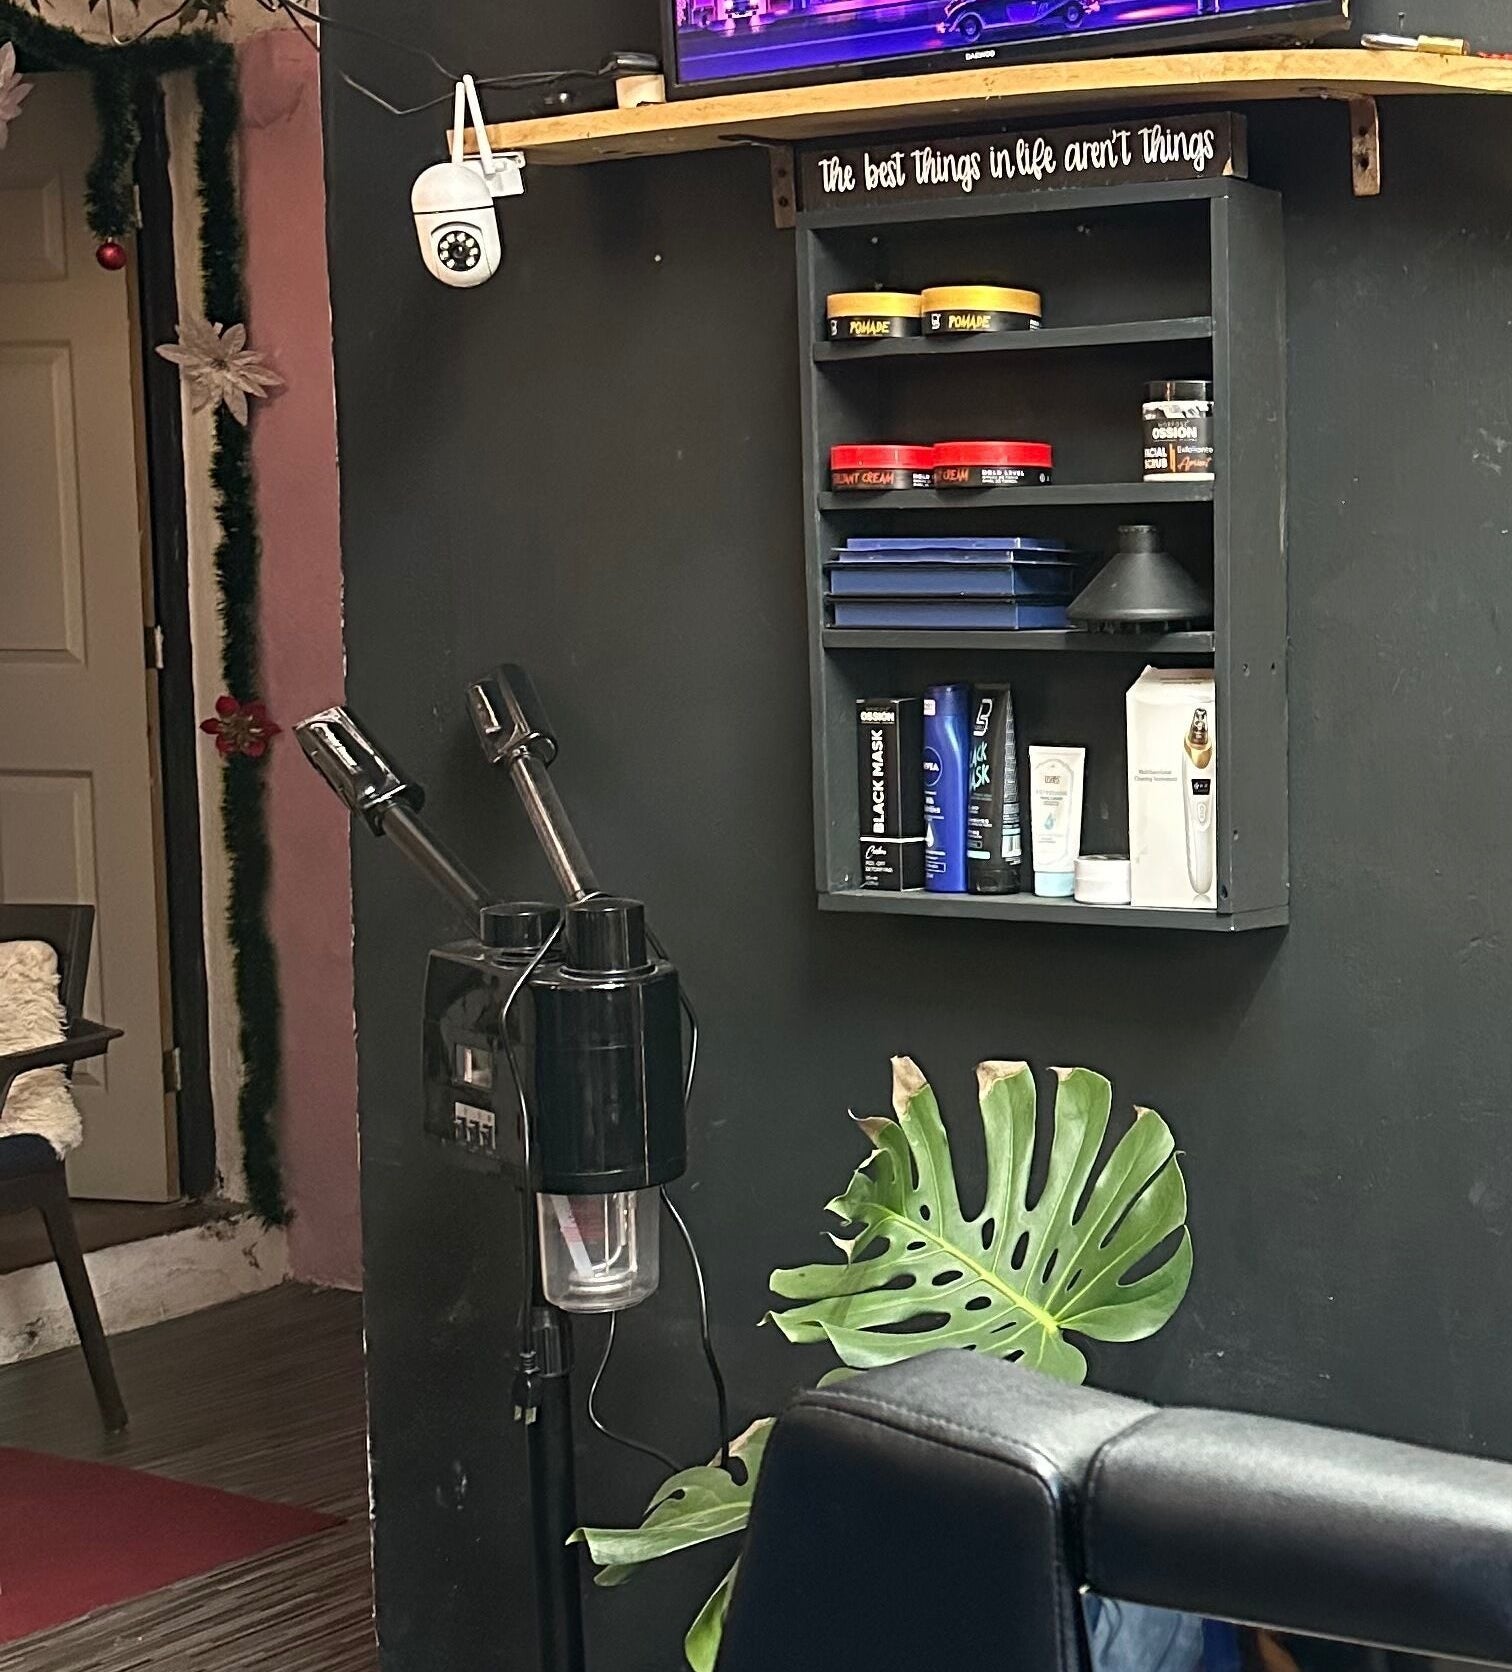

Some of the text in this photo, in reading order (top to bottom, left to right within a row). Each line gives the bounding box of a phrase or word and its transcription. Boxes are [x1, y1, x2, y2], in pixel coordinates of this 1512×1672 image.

[864, 152, 906, 190] best
[990, 146, 1015, 179] in
[1016, 138, 1057, 181] life
[1064, 129, 1132, 172] aren't
[850, 319, 890, 335] POMADE
[948, 314, 991, 330] POMADE
[1152, 426, 1198, 440] OSSION
[871, 729, 885, 834] BLACK MASK
